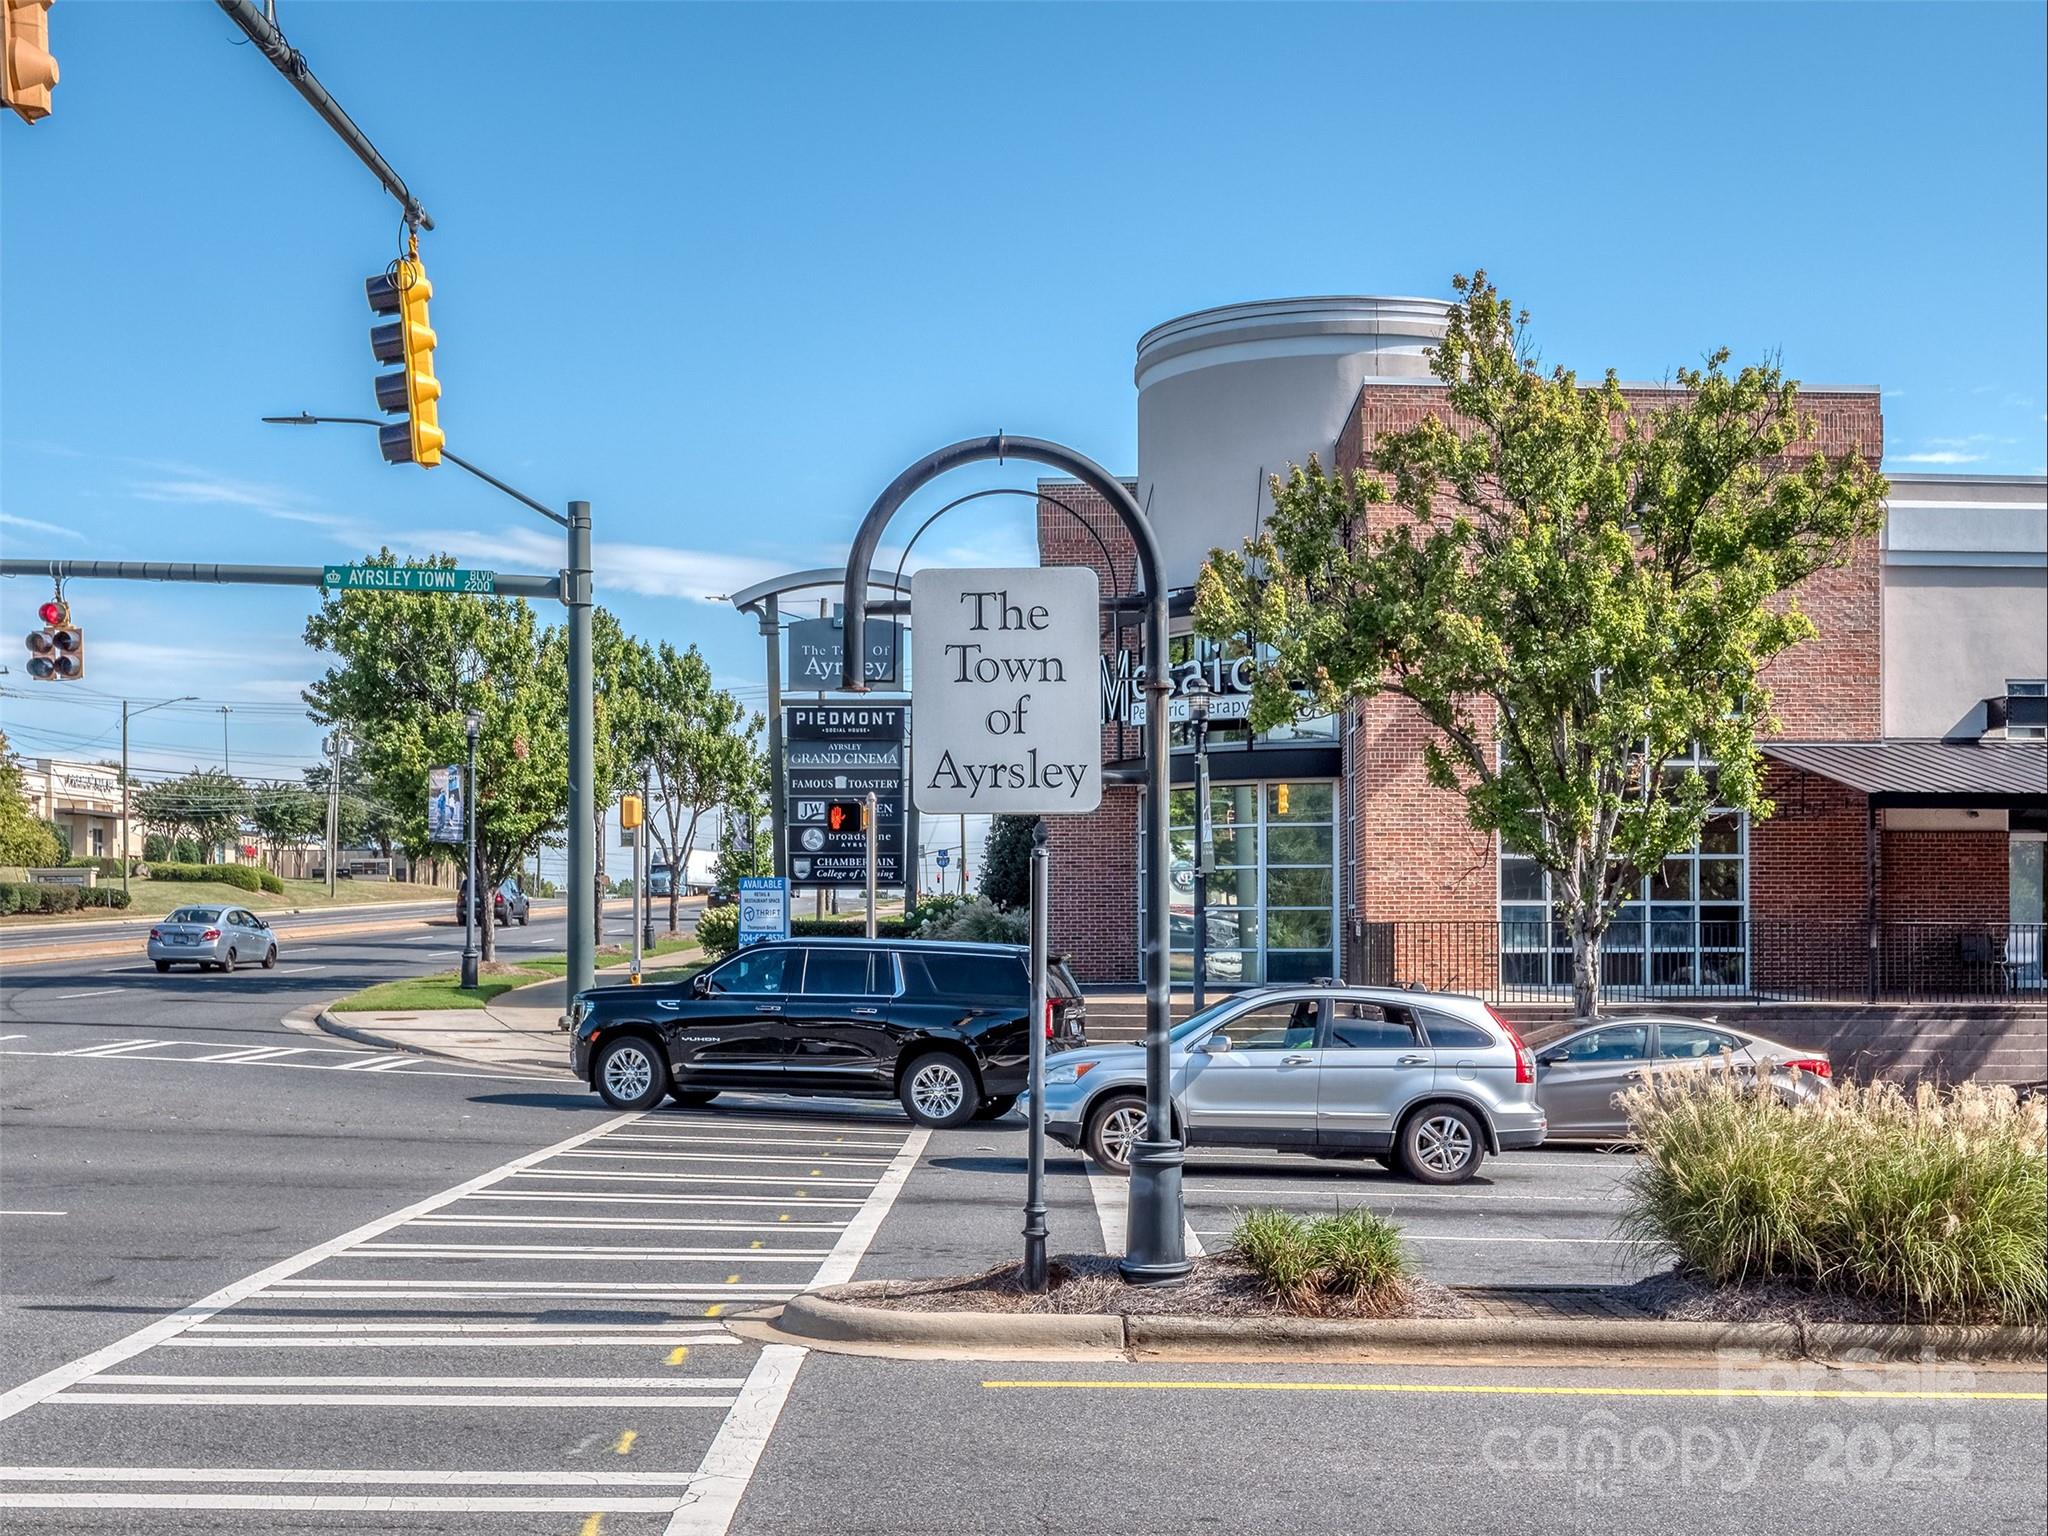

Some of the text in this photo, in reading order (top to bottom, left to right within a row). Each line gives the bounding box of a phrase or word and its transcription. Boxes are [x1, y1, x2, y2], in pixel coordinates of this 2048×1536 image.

[348, 569, 455, 587] AYRSLEY TOWN
[470, 570, 493, 581] BLVD
[464, 580, 490, 592] 2200
[960, 590, 1049, 631] The
[802, 645, 826, 656] The
[873, 645, 890, 656] Of
[804, 656, 887, 680] Ayrey
[945, 644, 1067, 683] Town
[1100, 643, 1252, 725] Maic
[985, 693, 1031, 735] of
[1133, 700, 1250, 720] Peric erapy
[796, 711, 896, 725] PIEDMONT
[828, 743, 861, 751] AYRSLEY
[791, 753, 897, 765] GRAND CINEMA
[927, 748, 1088, 799] Ayrsley
[792, 779, 899, 789] FAMOUS TOASTERY
[802, 803, 822, 819] JW
[828, 832, 891, 841] broadsne
[817, 858, 894, 866] CHAMBEAIN
[817, 869, 894, 879] College of Ning
[743, 880, 782, 889] AVAILABLE
